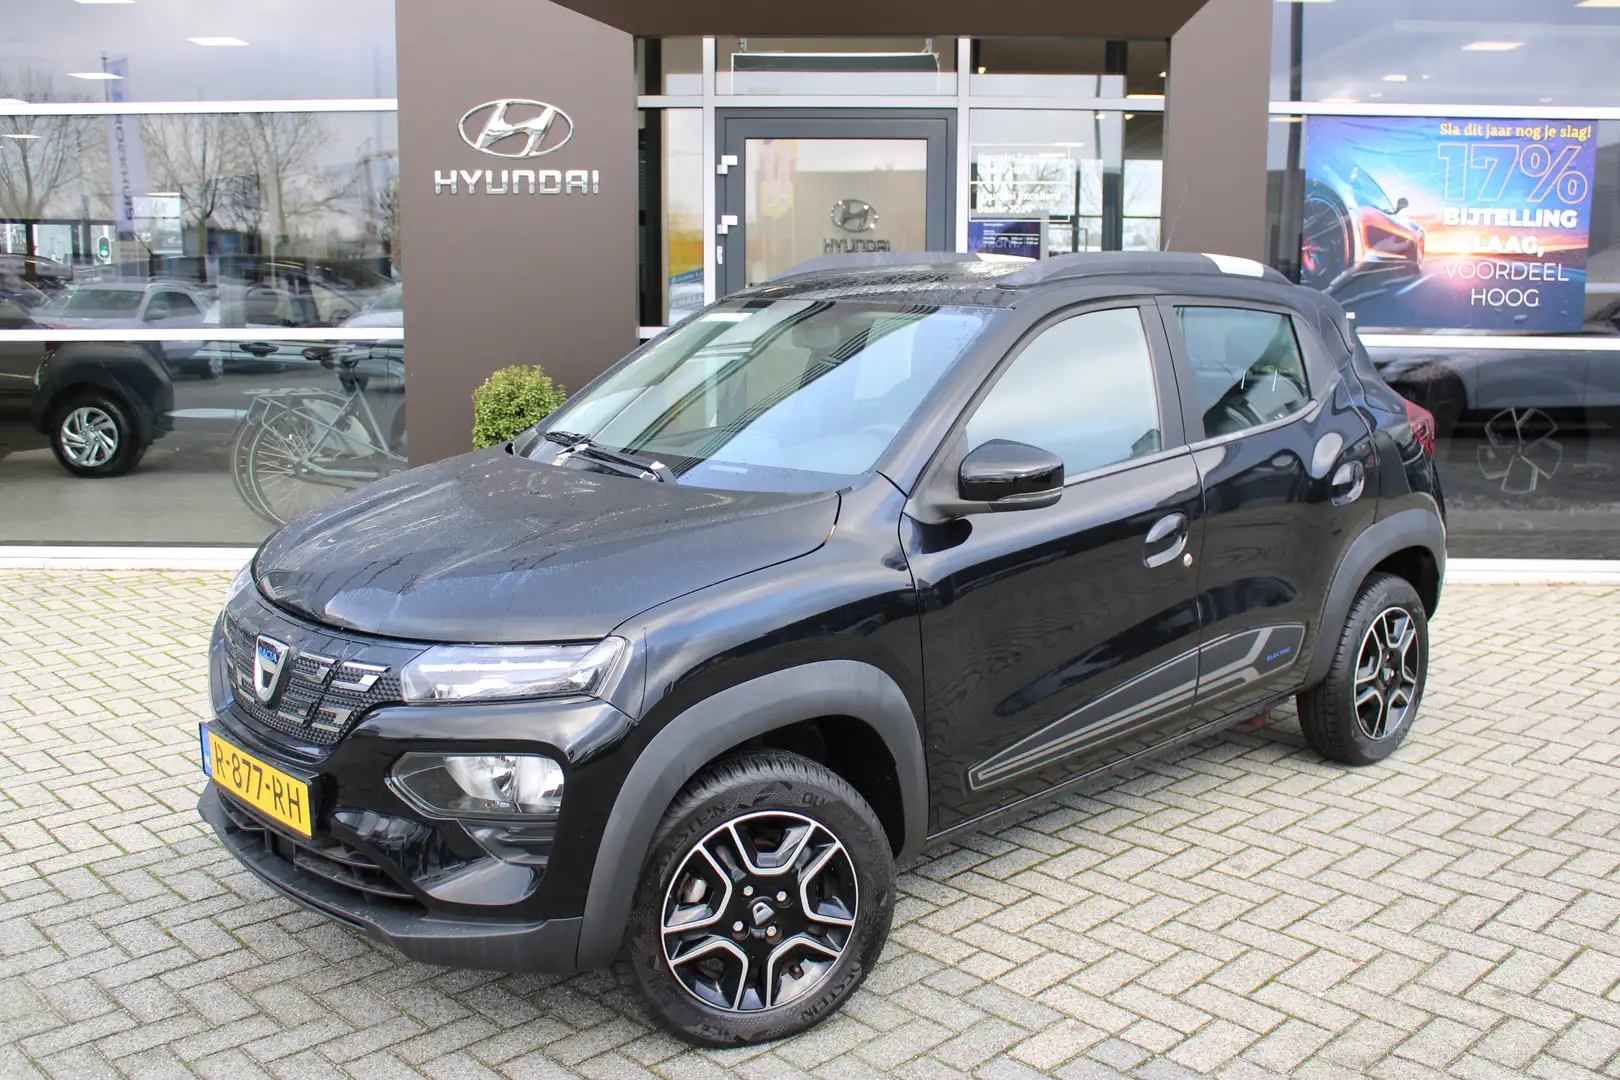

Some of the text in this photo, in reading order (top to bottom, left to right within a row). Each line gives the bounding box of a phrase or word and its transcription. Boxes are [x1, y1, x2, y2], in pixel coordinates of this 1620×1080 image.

[1440, 123, 1592, 141] Sla dit jaar nog je slag!
[434, 169, 600, 195] HYUNDAI
[1437, 142, 1589, 205] 17%
[1443, 207, 1578, 228] BIJTELLING
[823, 238, 891, 253] HYUNDAI
[1445, 261, 1570, 282] VOORDEEL
[1471, 287, 1541, 308] HOOG
[258, 645, 278, 663] DACIA
[213, 740, 303, 825] R-877-RH
